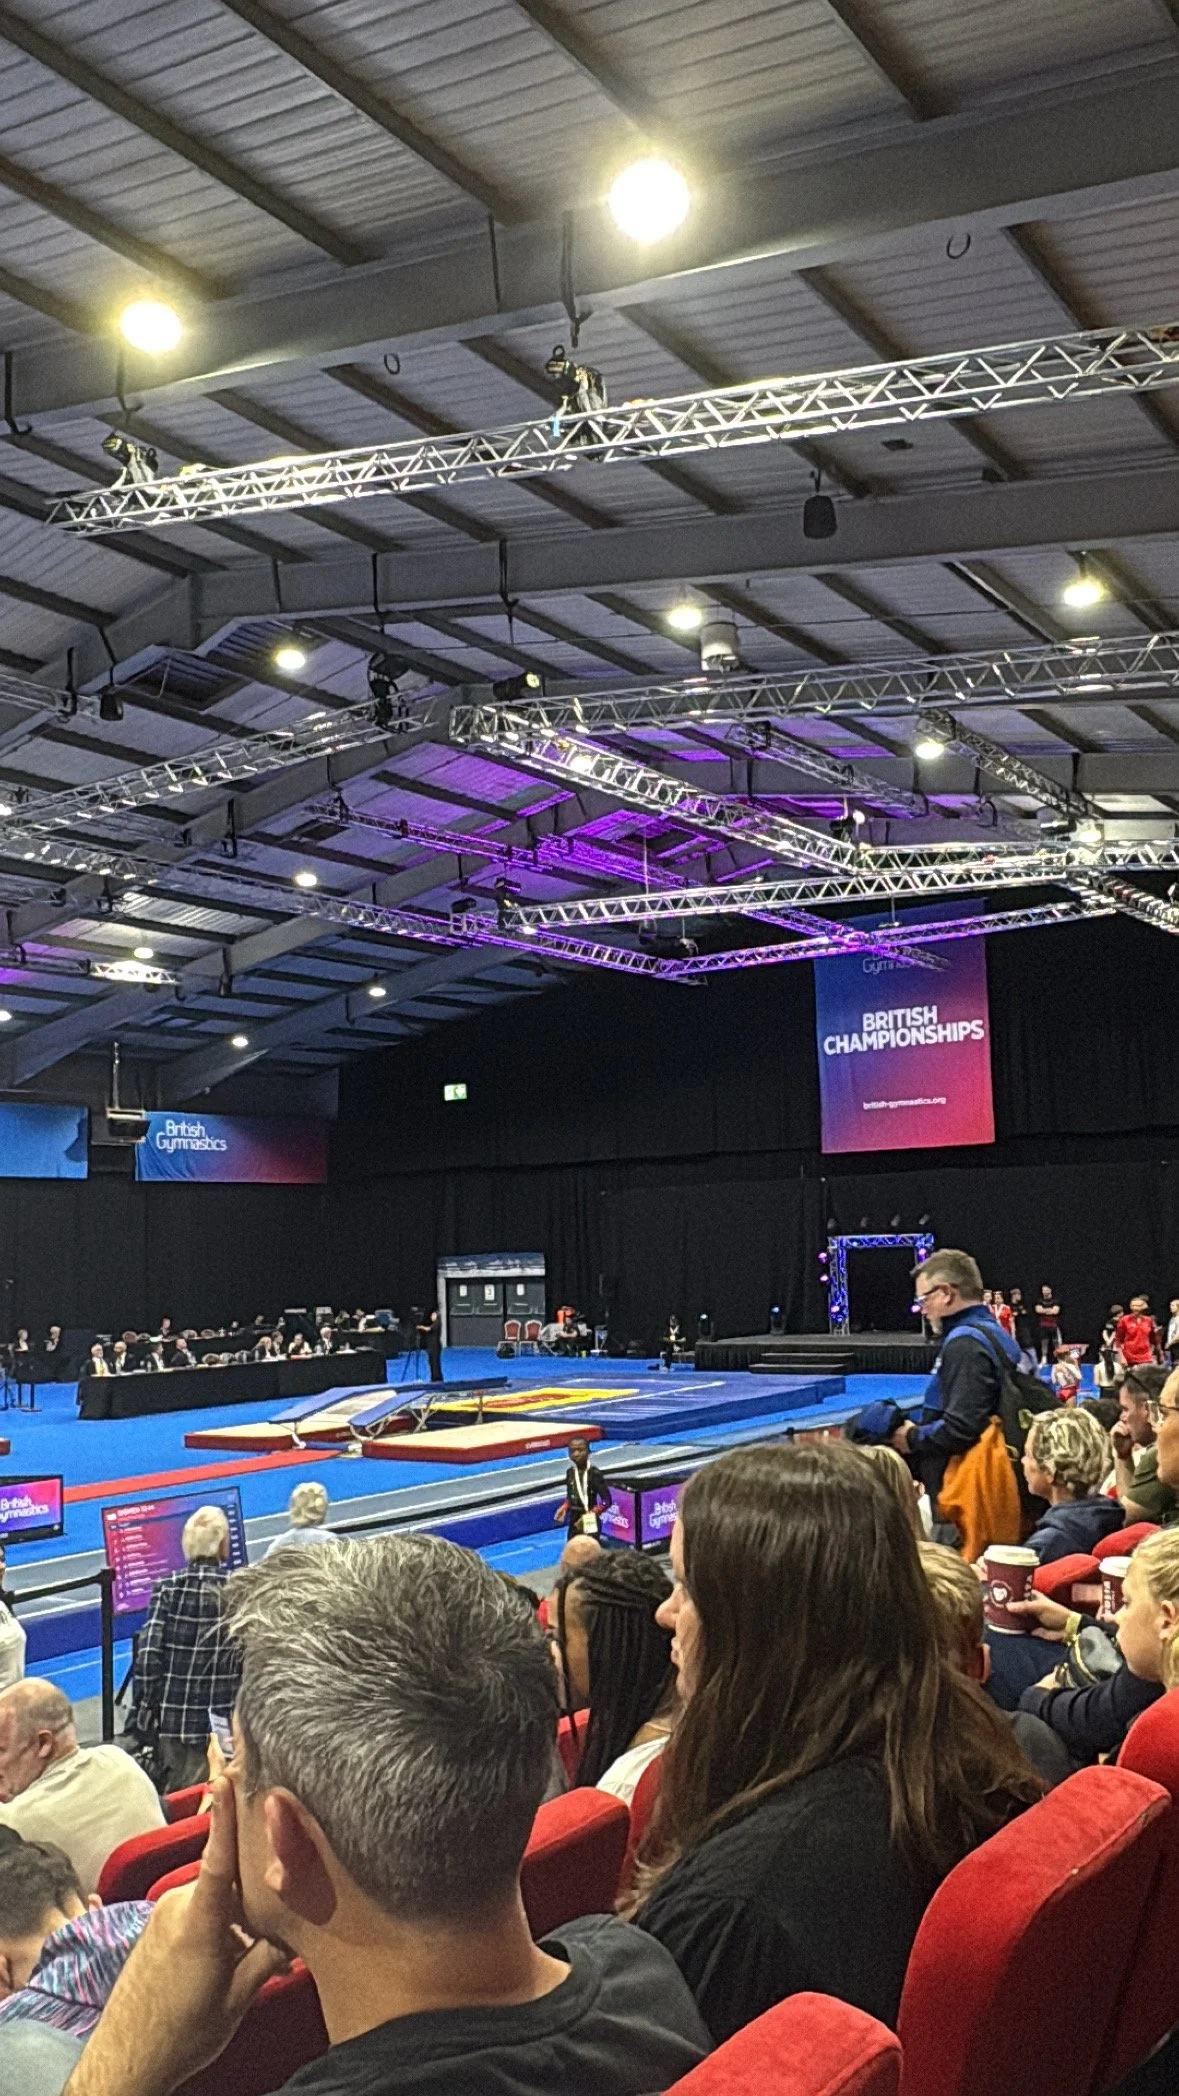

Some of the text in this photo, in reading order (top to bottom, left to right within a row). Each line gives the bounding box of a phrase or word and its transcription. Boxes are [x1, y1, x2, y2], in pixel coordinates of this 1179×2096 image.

[862, 1005, 938, 1032] BRITISH
[823, 1020, 985, 1056] CHAMPIONSHIPS
[165, 1119, 206, 1137] British
[156, 1131, 228, 1153] Gymnastics
[0, 1504, 49, 1523] ymnastics
